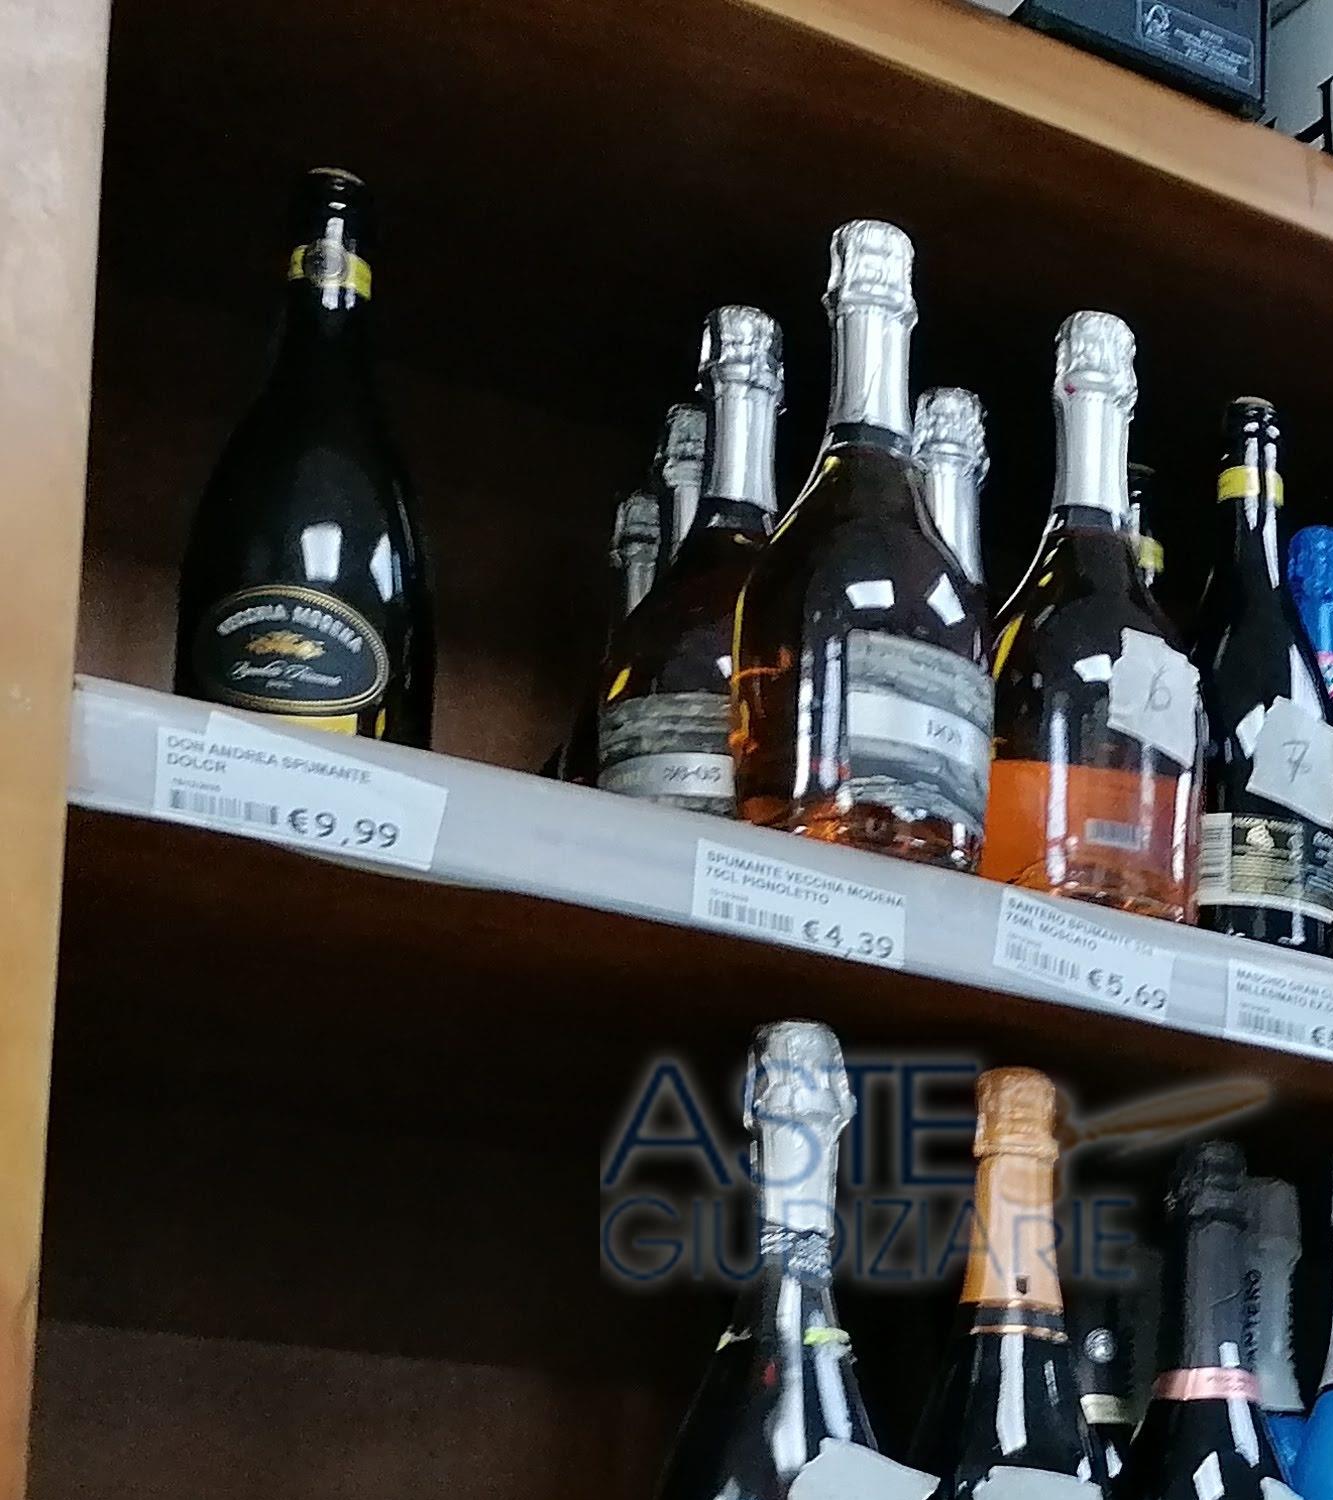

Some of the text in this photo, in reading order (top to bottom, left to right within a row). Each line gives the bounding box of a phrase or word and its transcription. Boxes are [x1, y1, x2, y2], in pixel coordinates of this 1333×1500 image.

[166, 736, 371, 785] DON ANDREA SPUMANTE
[287, 807, 400, 848] €9,99
[706, 850, 904, 907] SPUMANTE VECCHIA MODENA
[741, 872, 829, 906] PIGNOLETTO
[1008, 896, 1066, 926] SANTERO
[802, 919, 895, 958] €4,39
[1087, 967, 1168, 1011] €5,69
